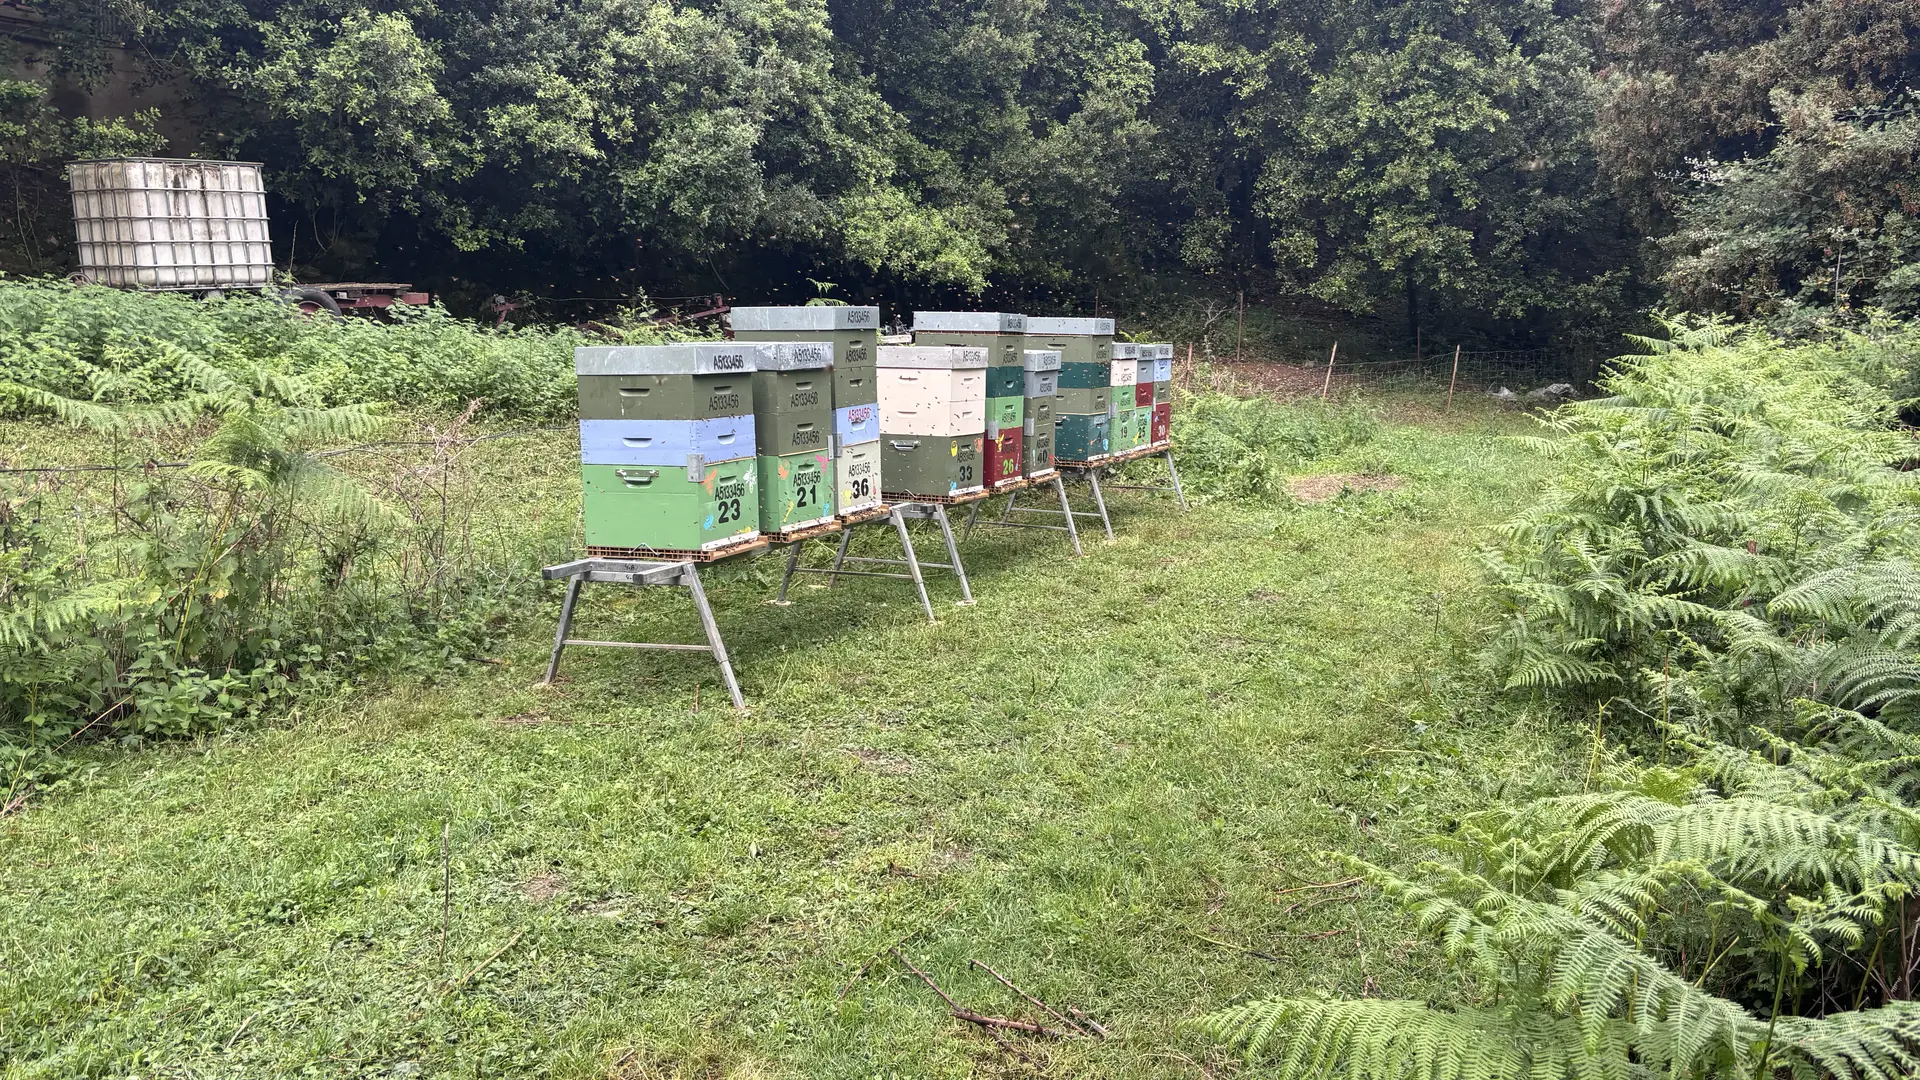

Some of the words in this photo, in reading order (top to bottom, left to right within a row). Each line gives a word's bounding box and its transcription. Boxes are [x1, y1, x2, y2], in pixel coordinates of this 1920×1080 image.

[714, 354, 744, 370] A5133456
[793, 348, 822, 363] A5133456
[709, 394, 740, 411] A5133456
[791, 391, 819, 408] A5133456
[792, 430, 820, 446] A5133456
[1037, 450, 1048, 464] 40
[848, 461, 871, 477] A5133456
[960, 465, 973, 482] 33
[1003, 458, 1014, 475] 26
[793, 471, 821, 487] A5133456
[715, 483, 745, 501] A5133456
[796, 484, 817, 508] 21
[852, 478, 869, 499] 36
[718, 499, 741, 524] 23
